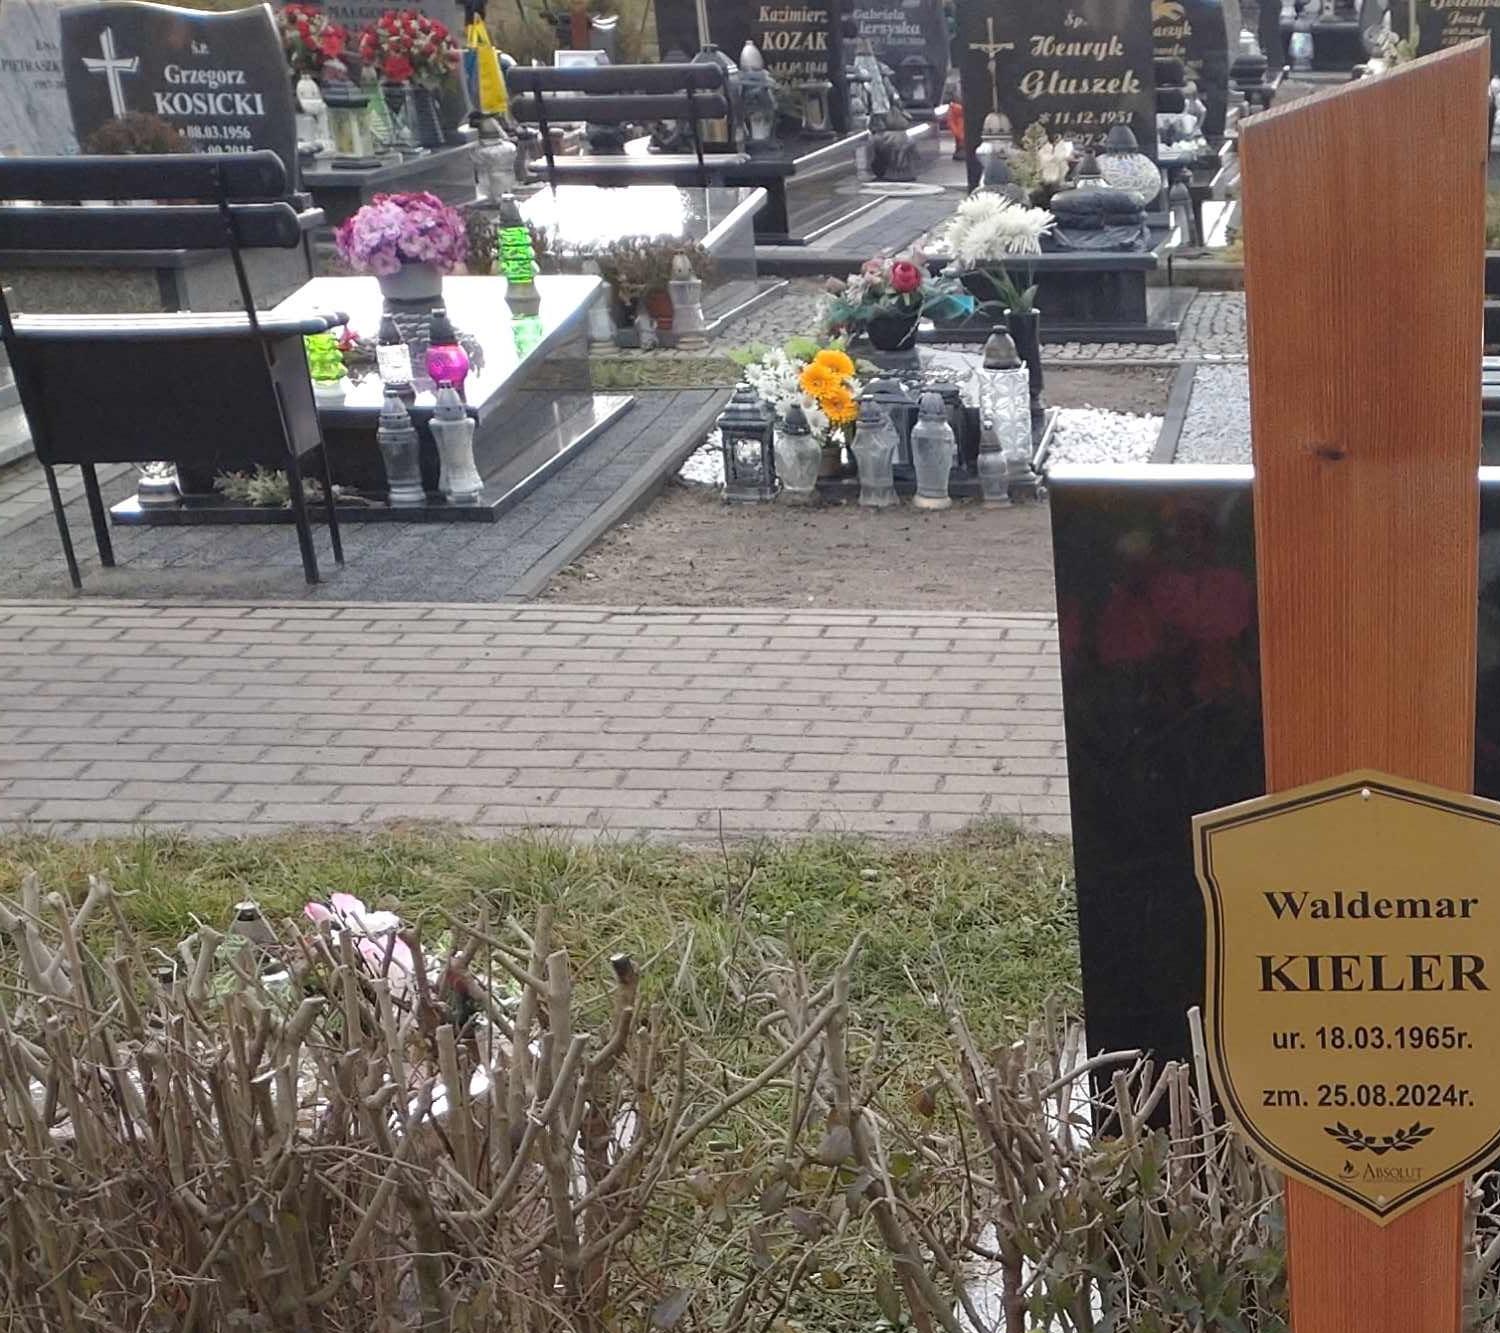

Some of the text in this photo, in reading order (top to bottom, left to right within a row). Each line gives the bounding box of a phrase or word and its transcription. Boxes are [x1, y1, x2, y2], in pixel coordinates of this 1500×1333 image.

[762, 31, 829, 50] KOZAK
[1029, 35, 1125, 61] Henryk
[164, 64, 246, 89] Grzegorz
[153, 92, 265, 116] KOSICKI
[1263, 890, 1480, 919] Waldemar
[1257, 954, 1491, 992] KIELER
[1273, 1026, 1474, 1050] ur. 18.03.1965r.
[1262, 1084, 1475, 1107] zm. 25.08.2024r.
